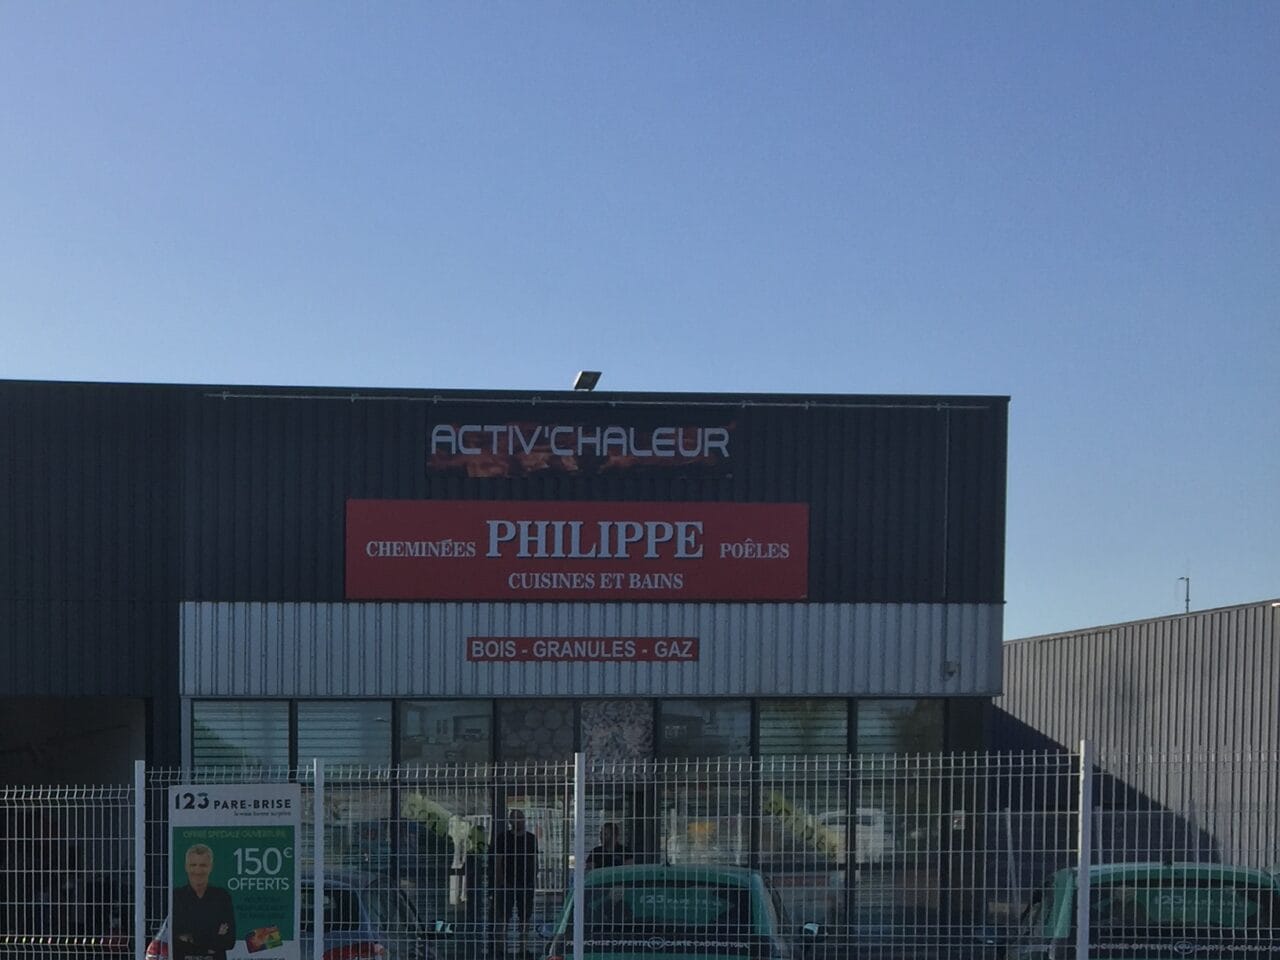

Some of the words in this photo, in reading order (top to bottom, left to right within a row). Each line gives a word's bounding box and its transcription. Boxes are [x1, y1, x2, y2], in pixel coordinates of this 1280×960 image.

[430, 424, 730, 458] ACTIV'CHALEUR
[365, 537, 477, 558] CHEMINÉES
[485, 519, 704, 560] PHILIPPE
[719, 538, 790, 559] POÊLES
[508, 572, 595, 590] CUISINES
[599, 573, 624, 590] ET
[628, 573, 684, 590] BAINS
[472, 640, 516, 657] BOIS
[533, 640, 637, 658] GRANULES
[654, 640, 693, 658] GAZ
[175, 792, 210, 809] 123
[213, 799, 292, 809] PARE-BRISE
[227, 877, 290, 891] OFFERTS
